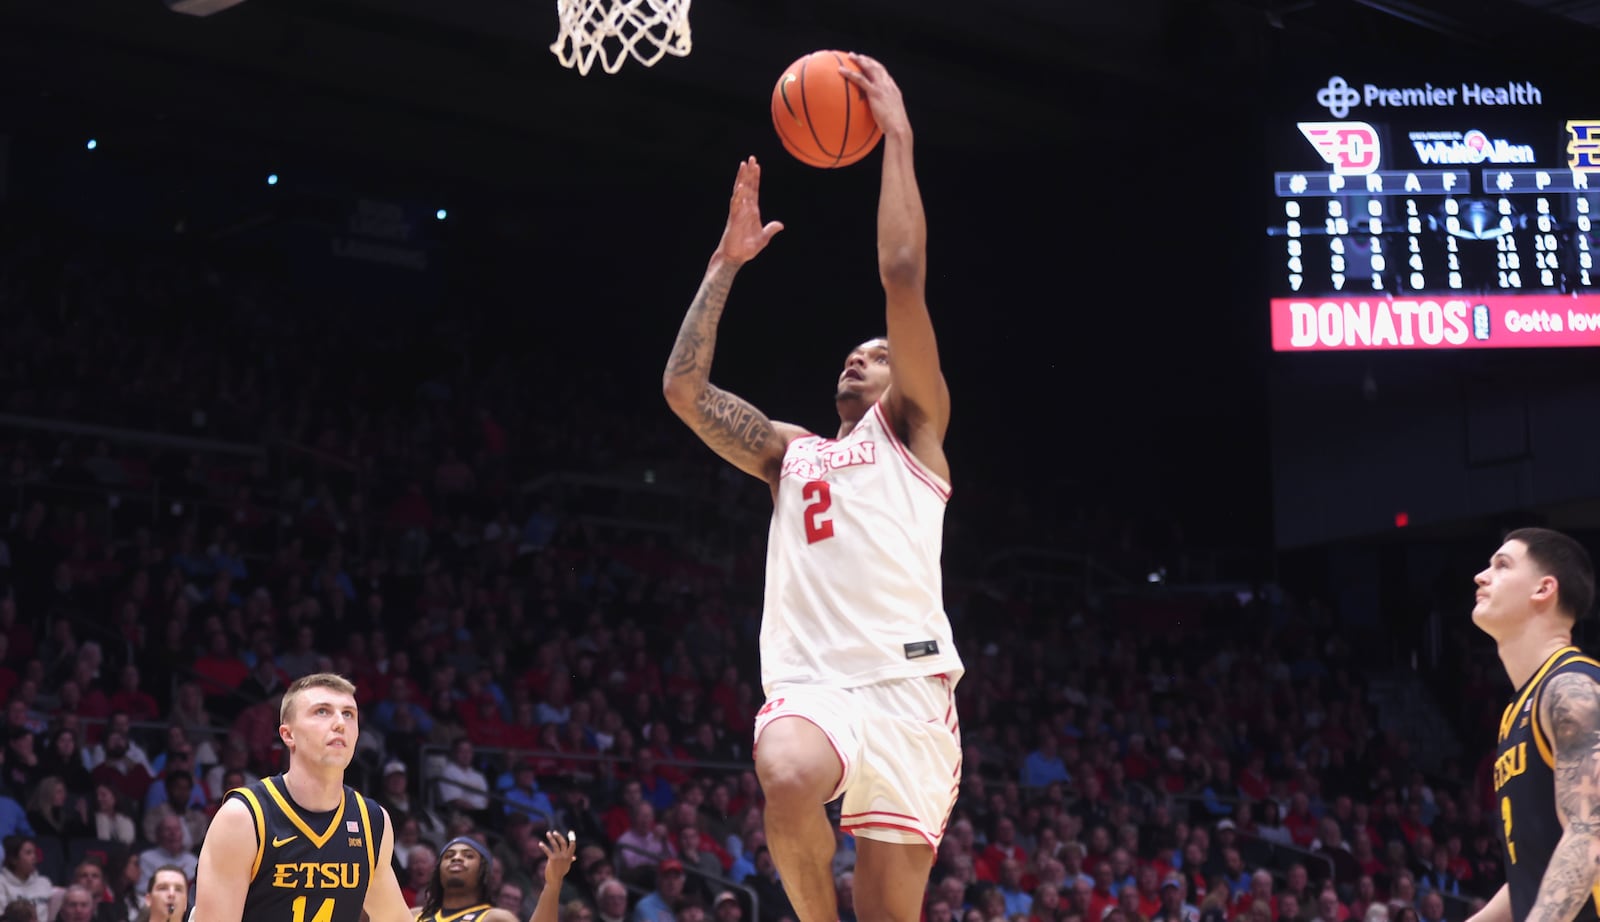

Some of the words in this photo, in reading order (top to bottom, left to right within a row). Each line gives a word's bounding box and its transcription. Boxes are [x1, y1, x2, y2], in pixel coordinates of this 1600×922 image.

[1364, 82, 1458, 107] Premier
[1462, 81, 1542, 106] Health
[1328, 174, 1345, 192] P
[1367, 174, 1383, 192] R
[1405, 173, 1422, 191] A
[1443, 172, 1457, 191] F
[1536, 171, 1551, 190] P
[1289, 301, 1470, 347] DONATOS
[1504, 309, 1563, 332] Gotta
[1568, 309, 1600, 332] lov
[697, 389, 770, 451] SACRIFICE
[802, 481, 834, 545] 2
[272, 862, 361, 889] ETSU
[291, 895, 336, 922] 14
